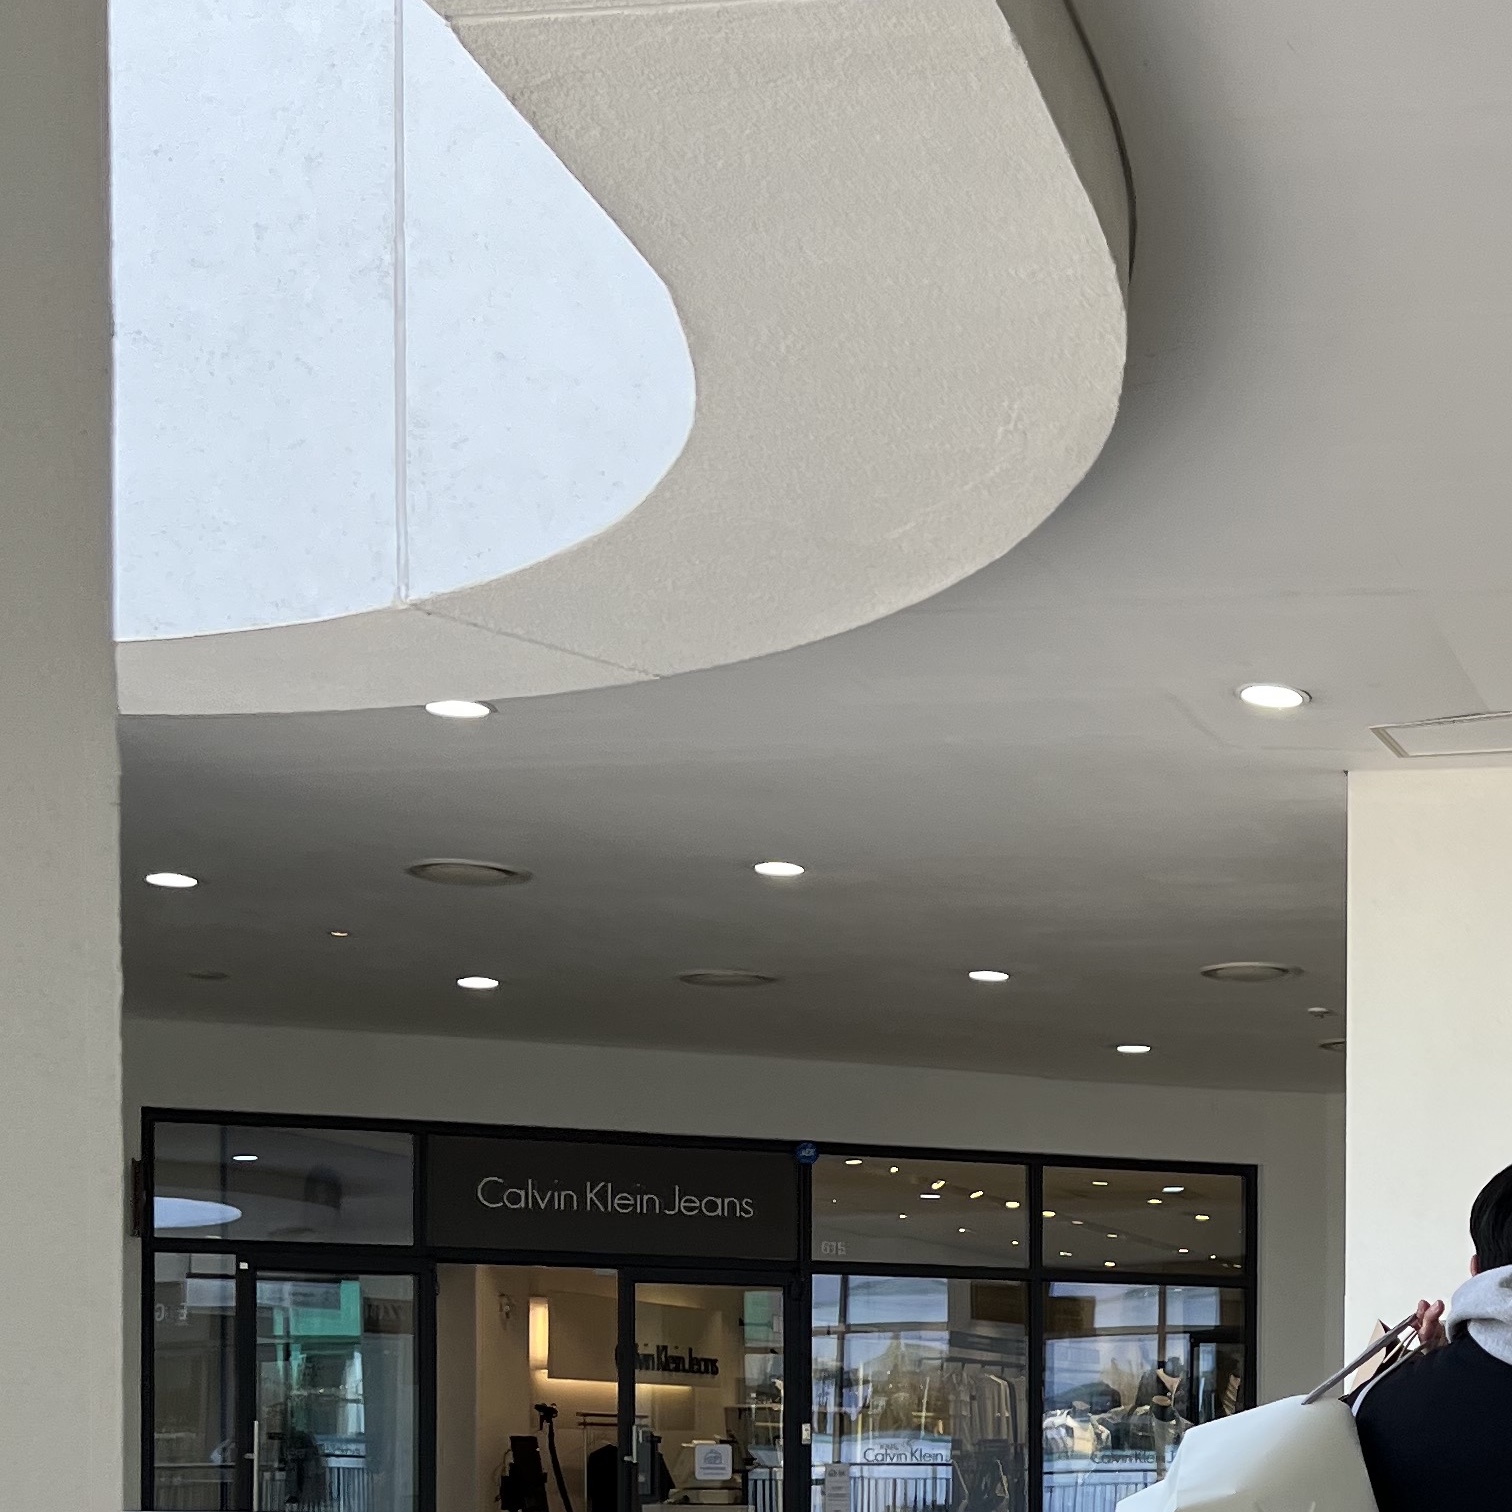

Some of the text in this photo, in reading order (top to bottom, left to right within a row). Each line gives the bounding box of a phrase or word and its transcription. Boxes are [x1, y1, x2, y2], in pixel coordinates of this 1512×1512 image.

[477, 1175, 755, 1218] Calvin Klein Jeans
[863, 1447, 908, 1463] Calvin
[911, 1447, 944, 1463] Klein
